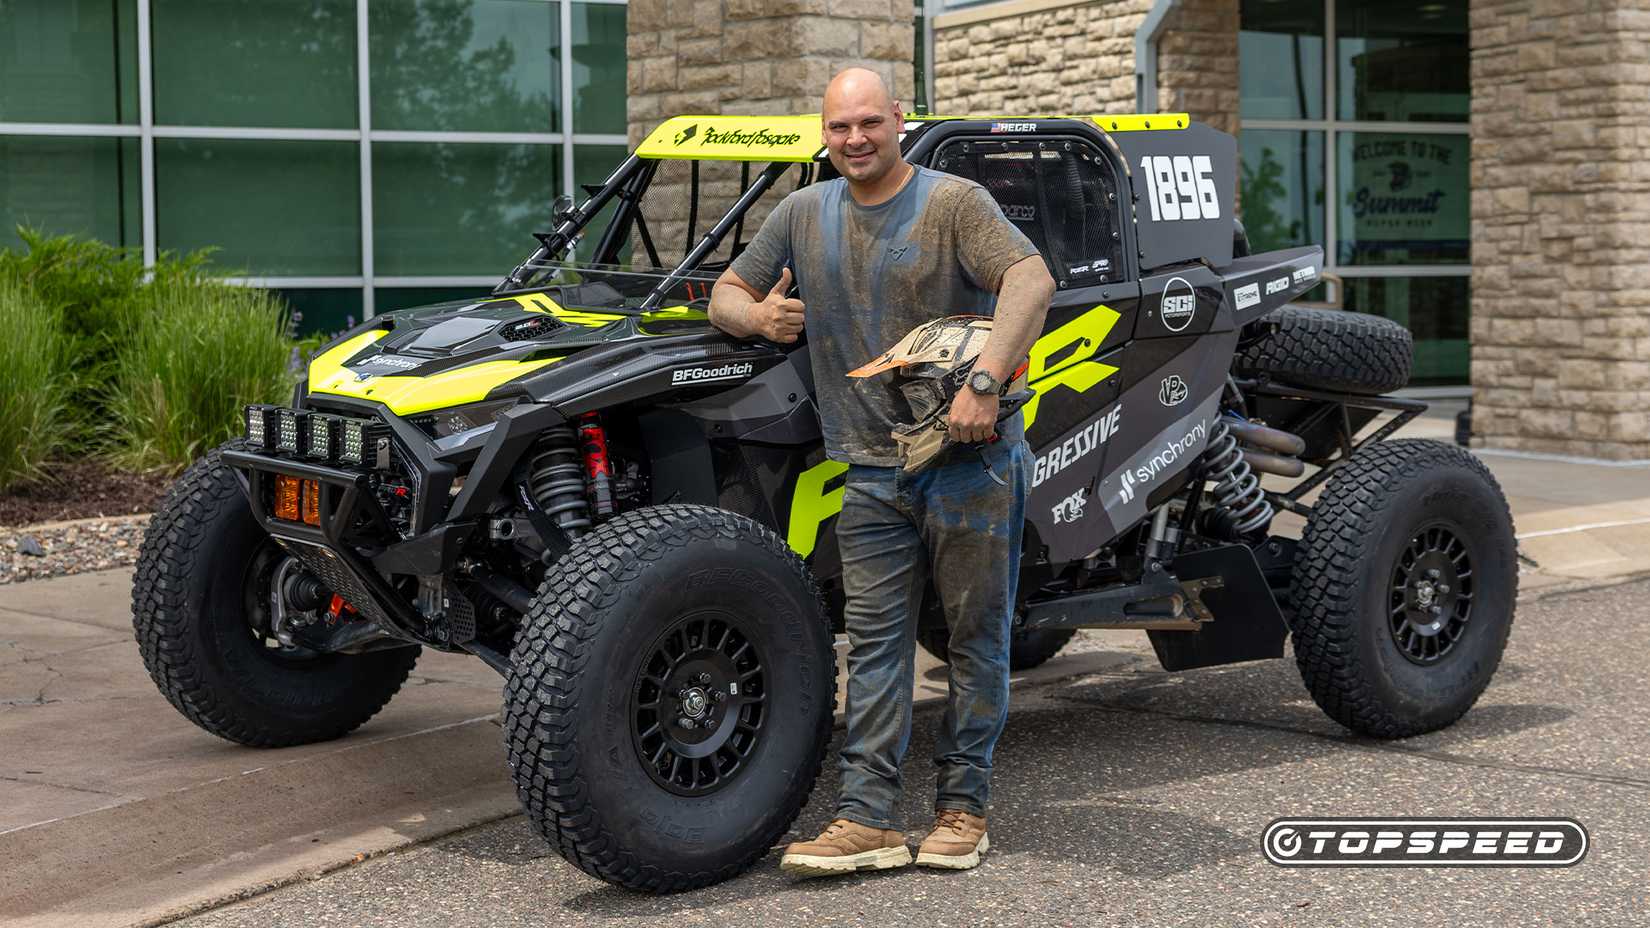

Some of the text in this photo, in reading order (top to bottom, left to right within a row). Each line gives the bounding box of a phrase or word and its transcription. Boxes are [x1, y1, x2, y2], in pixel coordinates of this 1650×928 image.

[1140, 155, 1220, 222] 1896
[1353, 186, 1448, 219] Summit
[672, 361, 753, 382] BFGoodrich
[1033, 403, 1122, 488] GRESSIVE
[1136, 418, 1208, 483] synchrony
[1051, 487, 1088, 525] FOX
